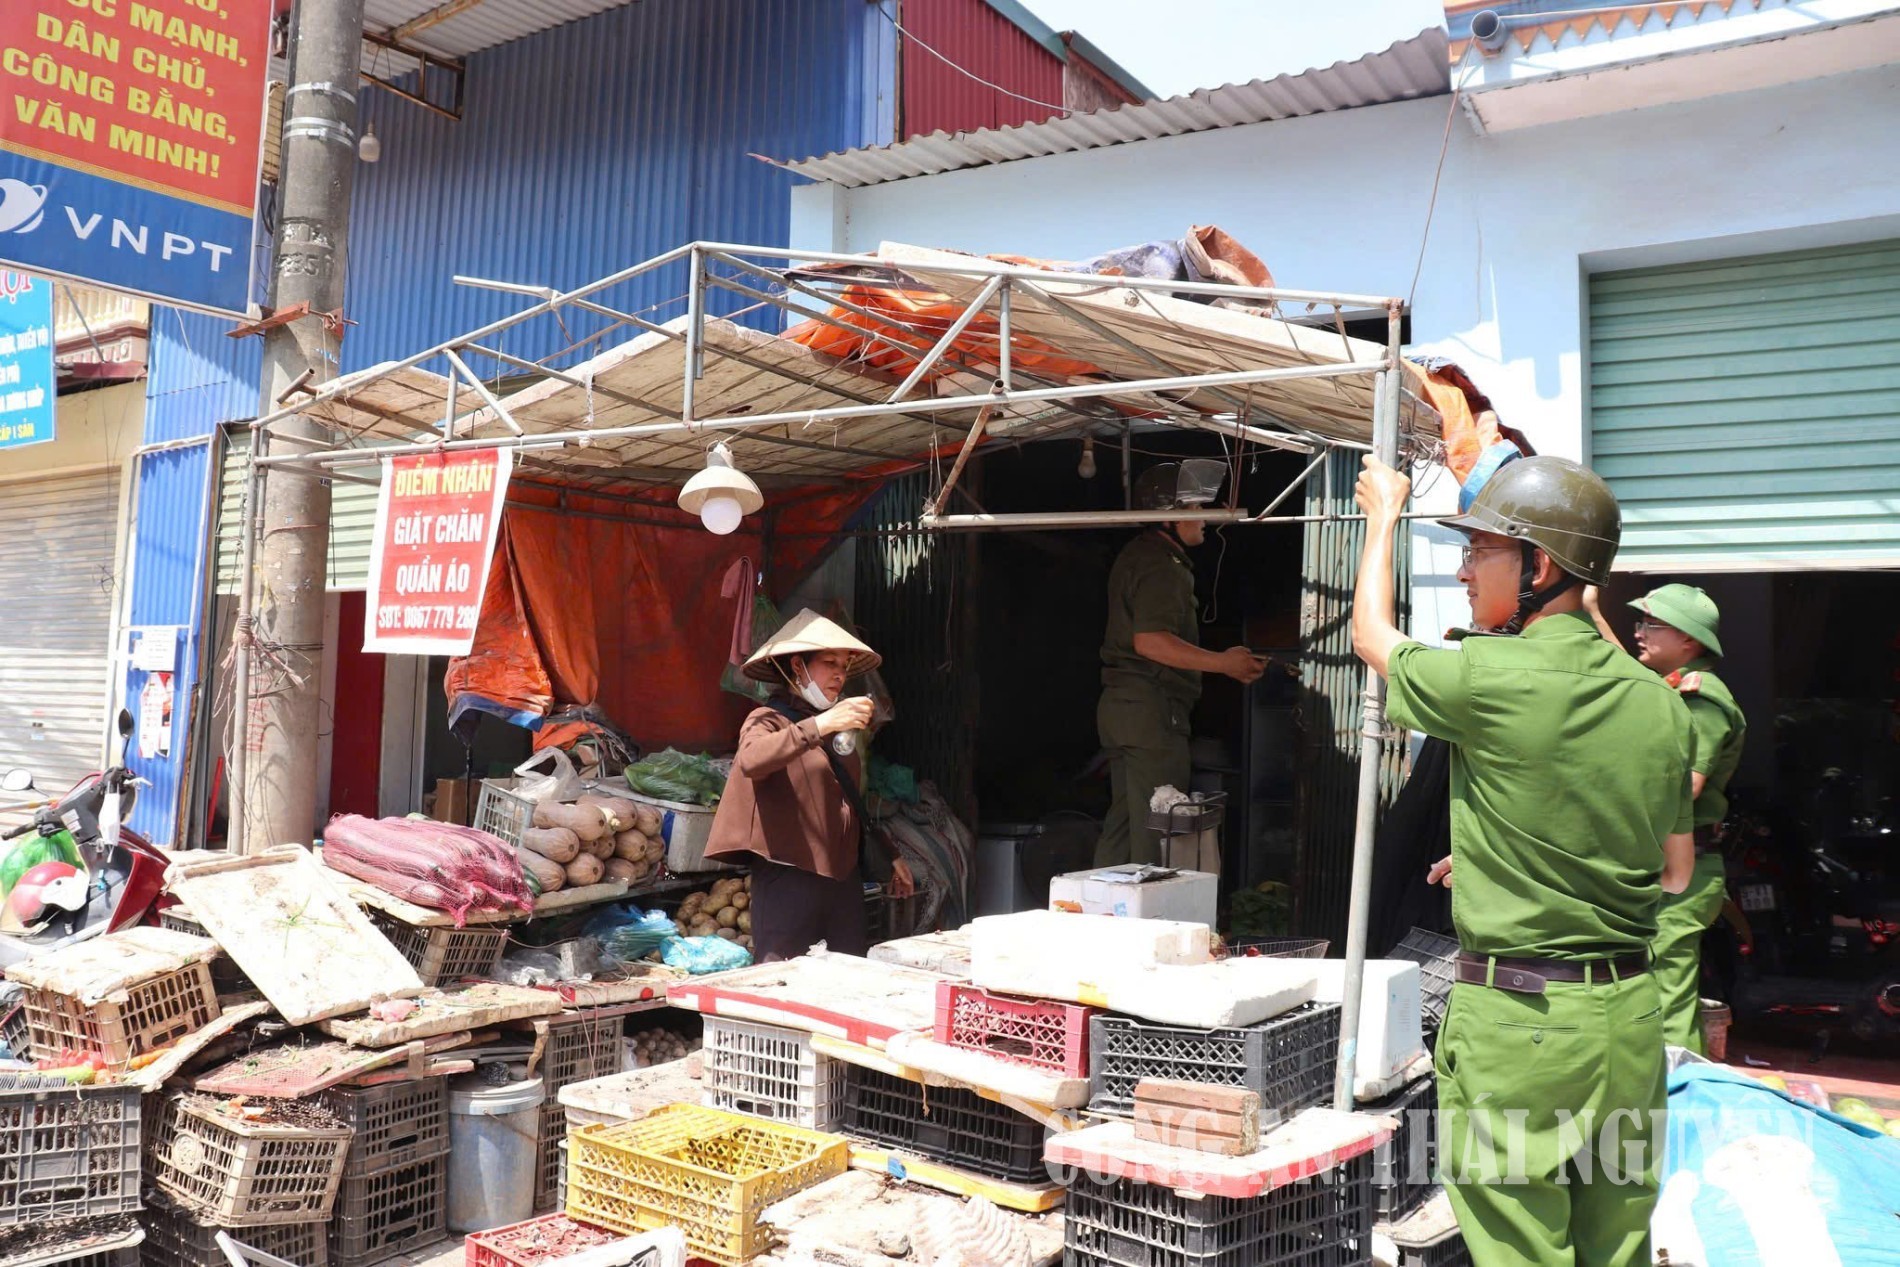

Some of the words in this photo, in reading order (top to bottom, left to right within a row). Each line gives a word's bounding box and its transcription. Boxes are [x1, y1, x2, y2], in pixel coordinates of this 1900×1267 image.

[36, 12, 120, 63] DÂN
[132, 47, 215, 97] CHỦ,
[129, 2, 248, 67] MẠNH,
[3, 47, 115, 105] CÔNG
[127, 87, 236, 145] BẰNG,
[14, 94, 96, 142] VĂN
[109, 124, 220, 178] MINH!
[64, 205, 232, 273] VNPT
[395, 457, 439, 497] ĐIỂM
[441, 458, 493, 499] NHẬN
[393, 510, 433, 551] GIẶT
[435, 507, 484, 544] CHĂN
[444, 557, 471, 593] ÁO
[432, 606, 455, 629] 779
